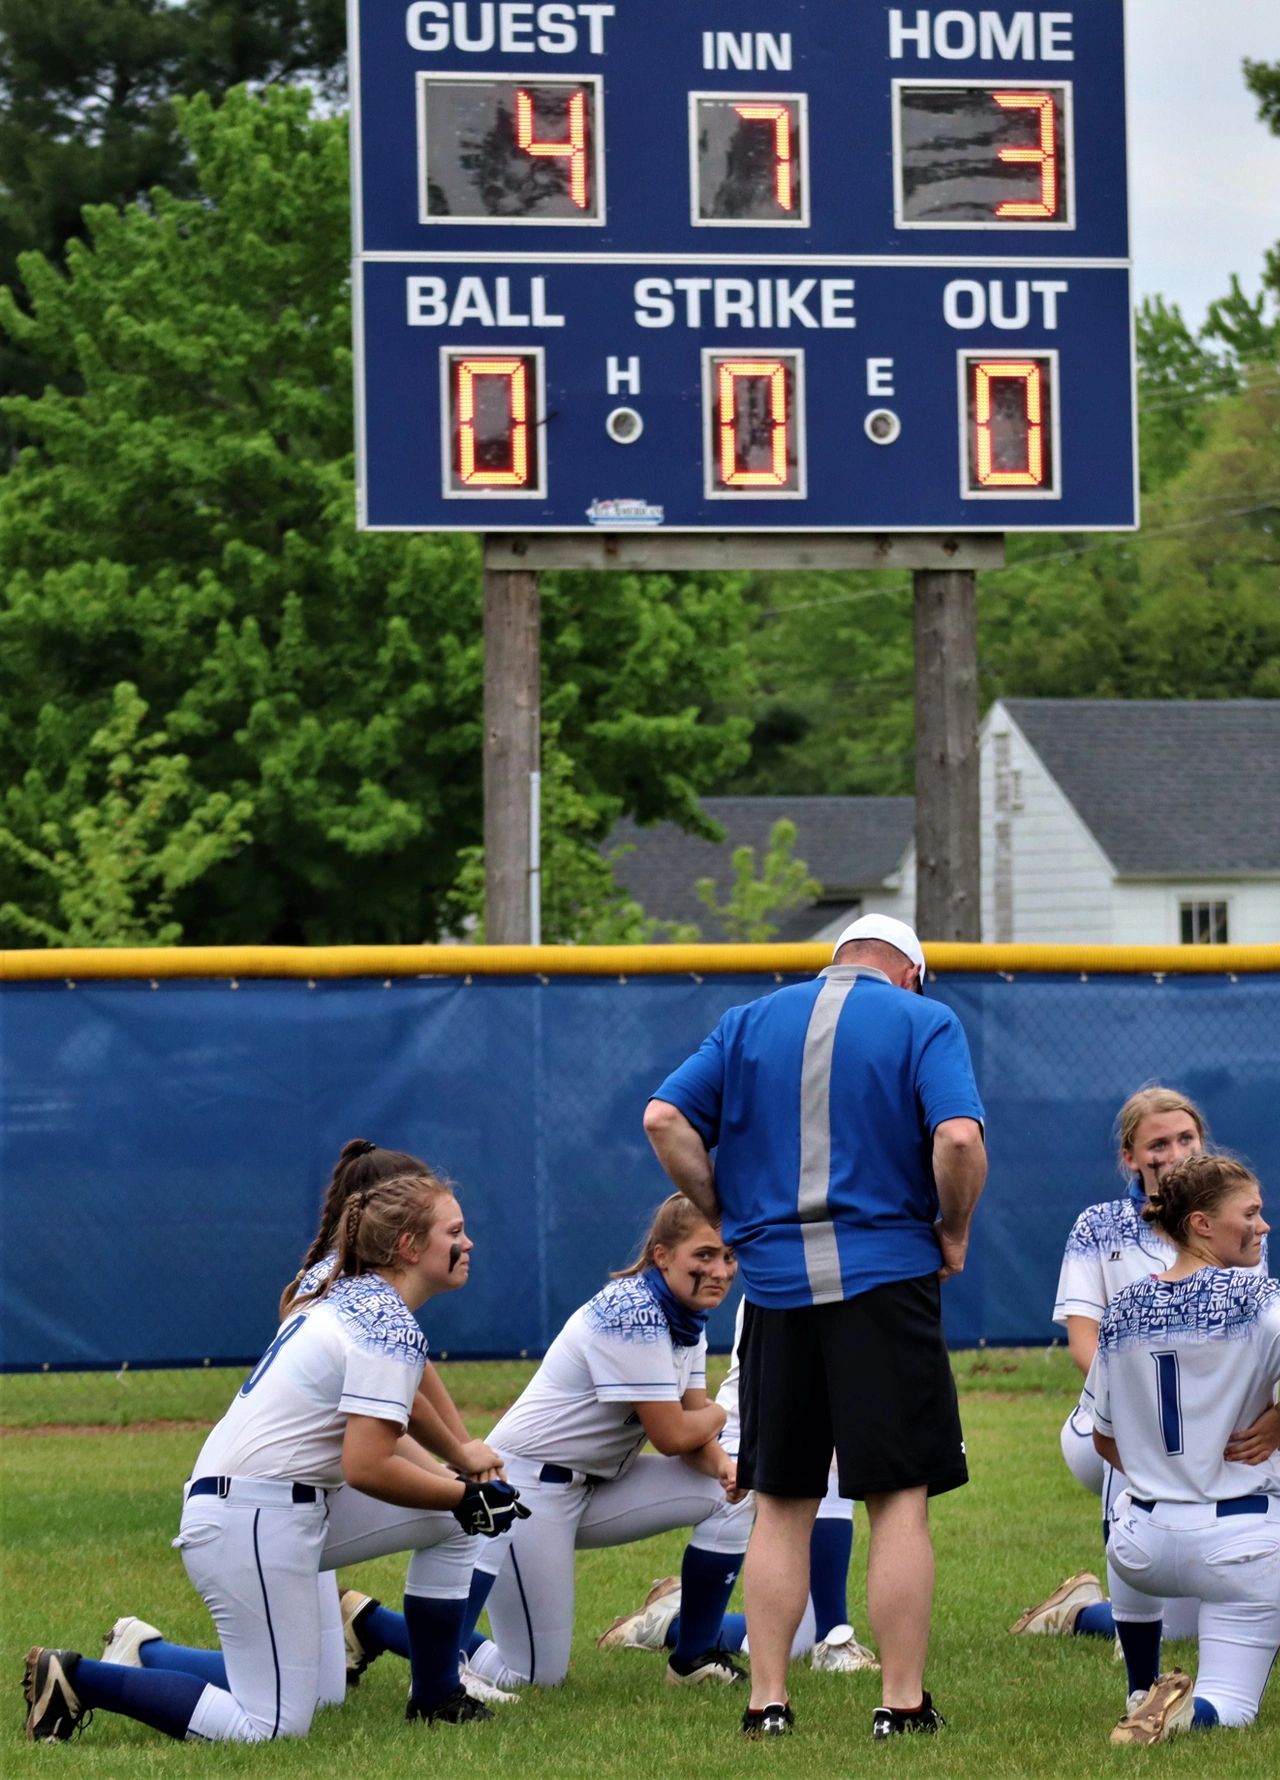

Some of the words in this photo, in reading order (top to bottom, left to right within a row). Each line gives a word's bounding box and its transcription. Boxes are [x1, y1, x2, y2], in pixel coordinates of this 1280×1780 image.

[406, 1, 615, 54] GUEST
[702, 31, 792, 71] INN
[888, 9, 1074, 61] HOME
[514, 89, 589, 209] 4
[735, 104, 794, 211] 7
[991, 90, 1057, 217] 3
[406, 276, 565, 327] BALL
[634, 277, 856, 329] STRIKE
[943, 279, 1068, 330] OUT
[606, 356, 640, 395] H
[866, 357, 895, 396] E
[456, 357, 528, 488] 0
[716, 359, 790, 488] 0
[973, 359, 1043, 487] 0
[1150, 1350, 1184, 1456] 1
